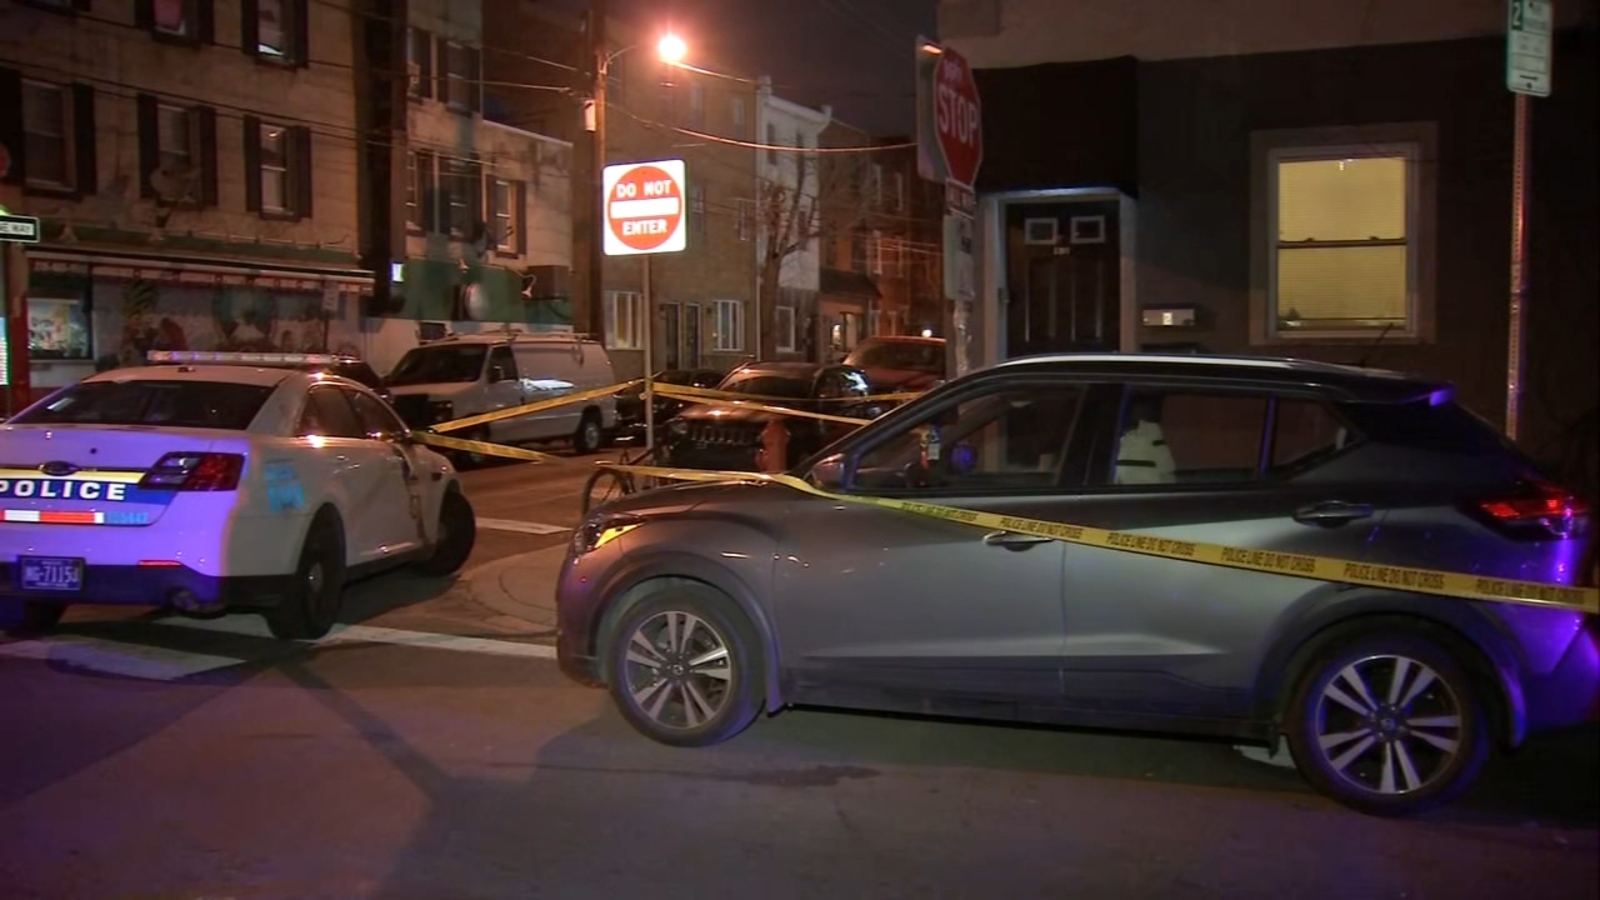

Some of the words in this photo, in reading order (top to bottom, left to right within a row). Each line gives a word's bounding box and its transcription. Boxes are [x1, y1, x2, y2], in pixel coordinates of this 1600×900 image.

[938, 83, 978, 147] STOP
[616, 182, 637, 198] DO
[643, 179, 672, 197] NOT
[622, 218, 667, 236] ENTER
[1106, 531, 1131, 547] POLICE
[1130, 534, 1147, 549] LINE
[1170, 540, 1195, 556] CROSS
[1221, 547, 1245, 563] POLICE
[1245, 550, 1263, 566] LINE
[1263, 552, 1275, 567] DO
[1275, 554, 1290, 569] NOT
[1290, 556, 1315, 573] CROSS
[1344, 563, 1370, 580] POLICE
[1370, 566, 1388, 582] LINE
[1388, 568, 1400, 584] DO
[1401, 569, 1416, 585] NOT
[1418, 571, 1444, 589] CROSS
